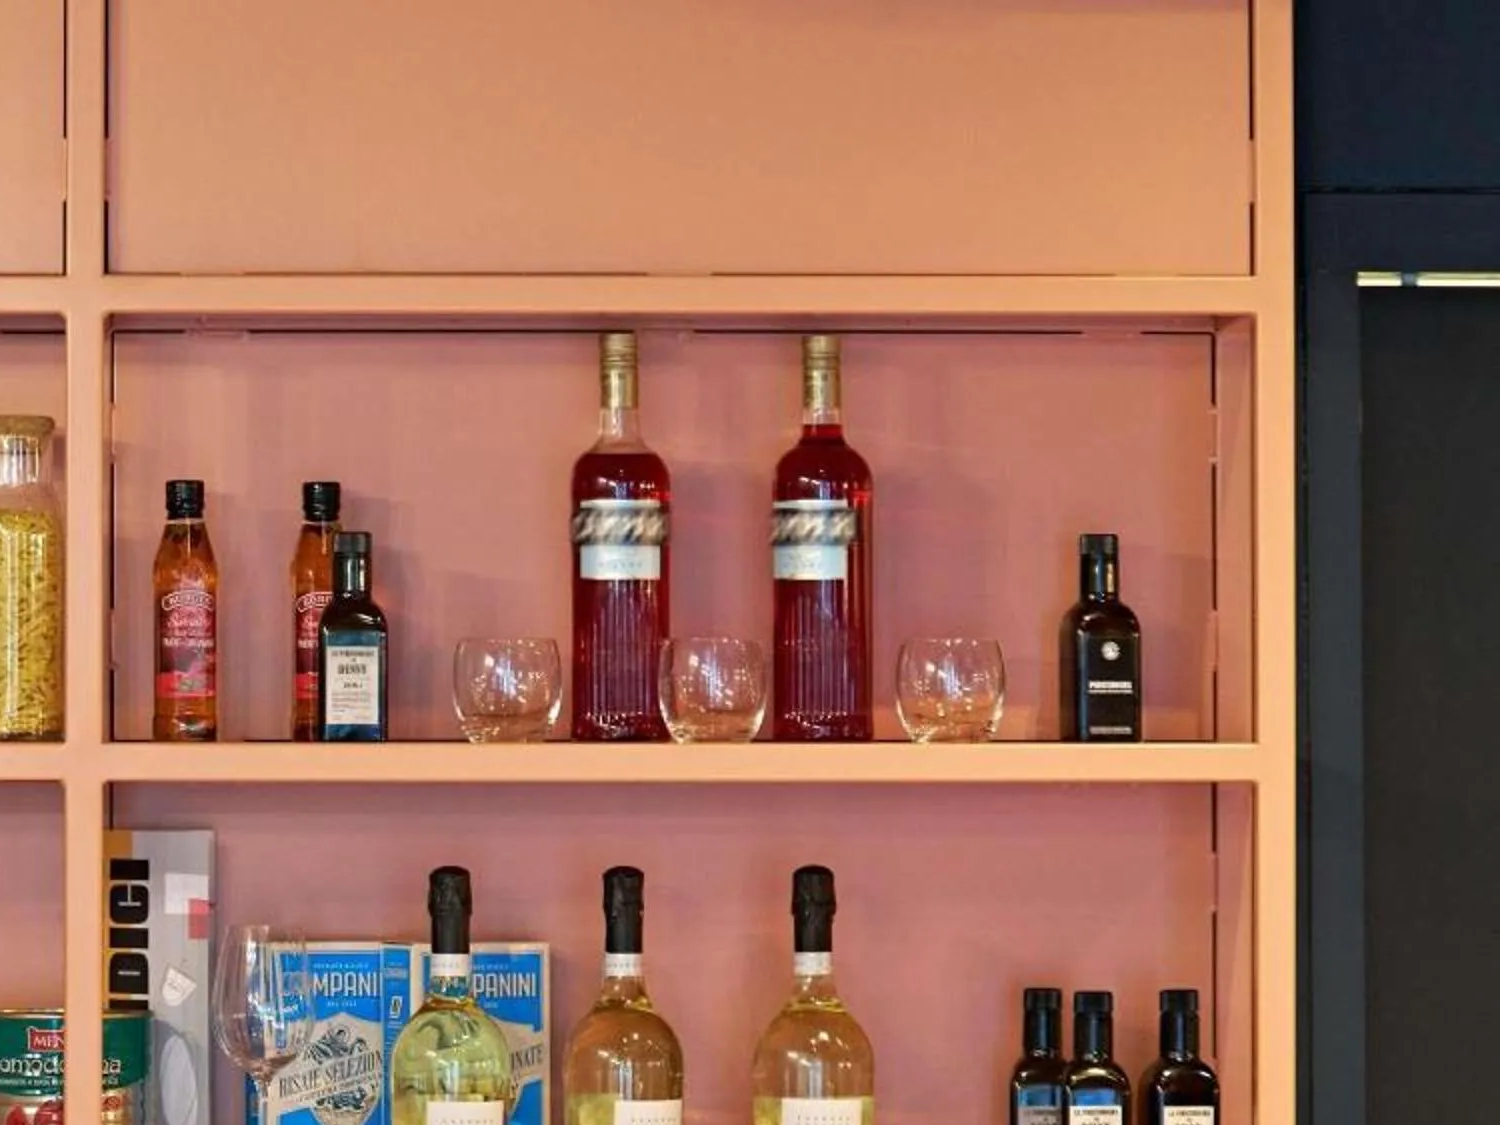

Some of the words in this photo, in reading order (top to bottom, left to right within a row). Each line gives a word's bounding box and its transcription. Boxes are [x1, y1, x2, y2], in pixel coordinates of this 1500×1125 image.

[312, 971, 378, 997] MPANI
[472, 973, 536, 998] PANINI
[33, 1036, 65, 1048] MEN
